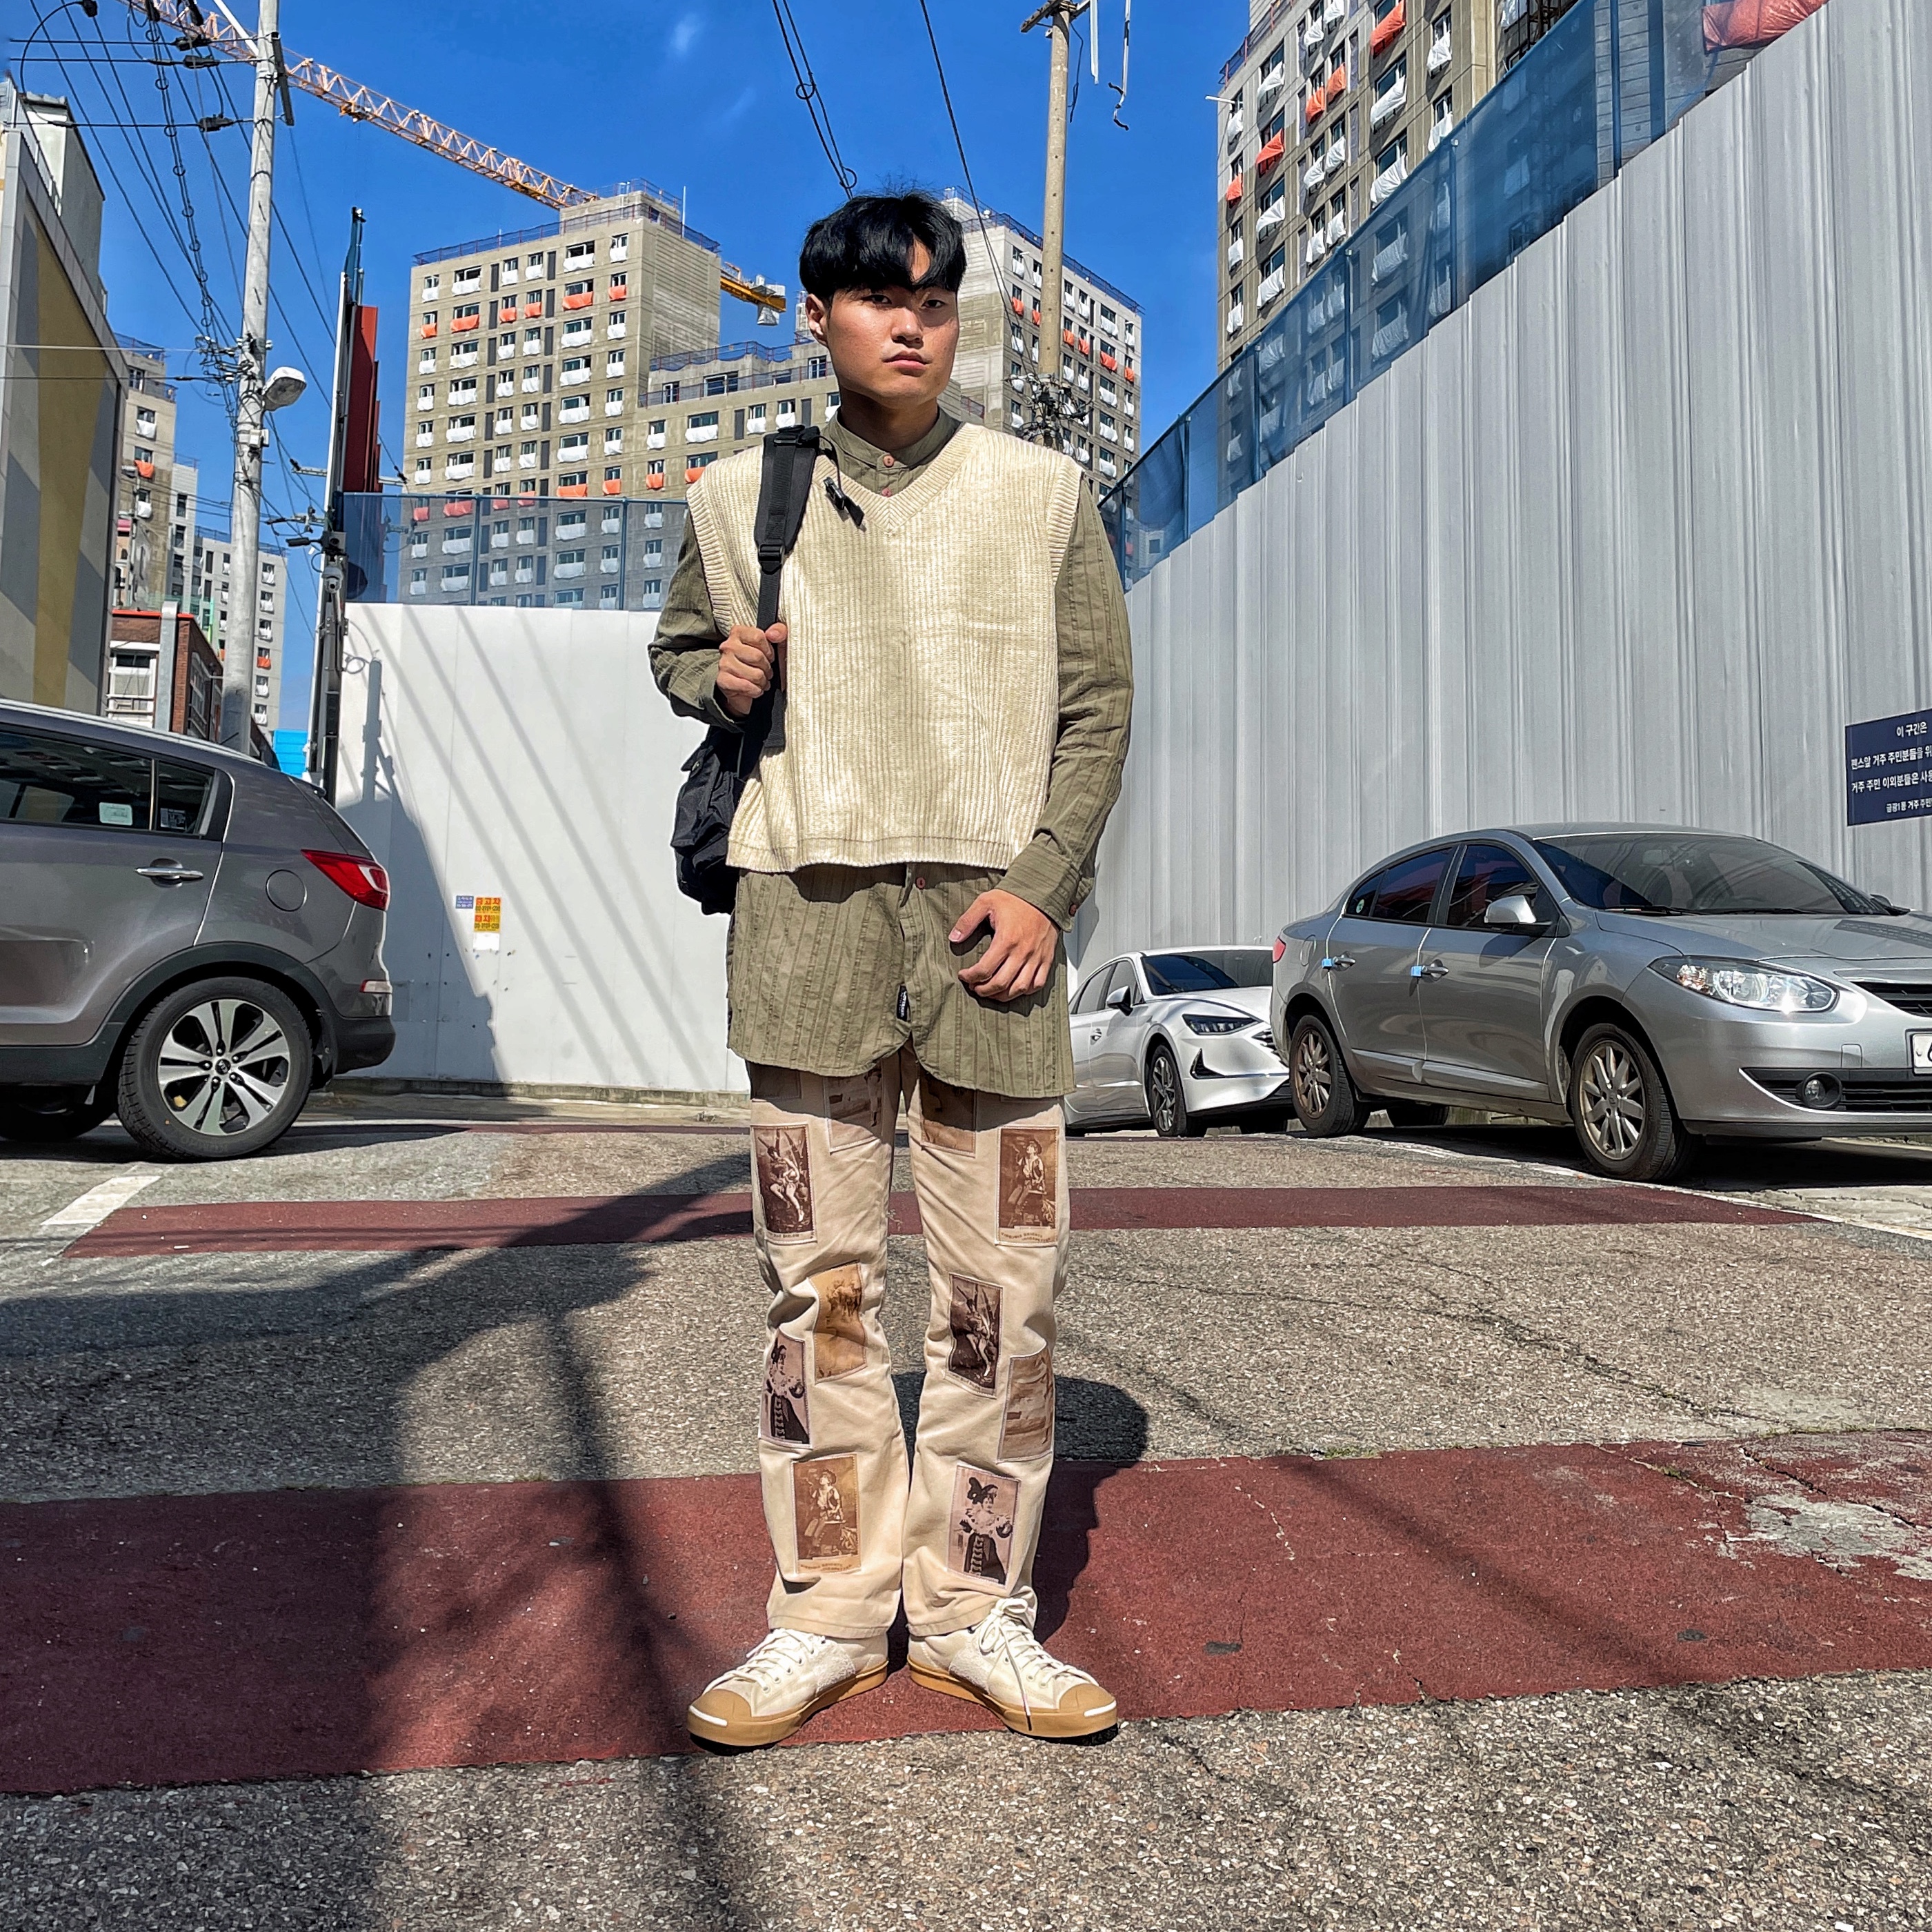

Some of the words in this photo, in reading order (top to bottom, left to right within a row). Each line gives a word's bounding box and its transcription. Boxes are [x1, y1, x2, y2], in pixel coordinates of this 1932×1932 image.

[1897, 726, 1904, 737] 이
[1905, 721, 1928, 737] 구간은
[1873, 754, 1886, 766] 거주
[1888, 747, 1923, 764] 주민분들을
[1851, 781, 1865, 793] 거주
[1866, 778, 1881, 791] 주민
[1882, 773, 1919, 788] 이외분들은
[1908, 800, 1920, 810] 거주
